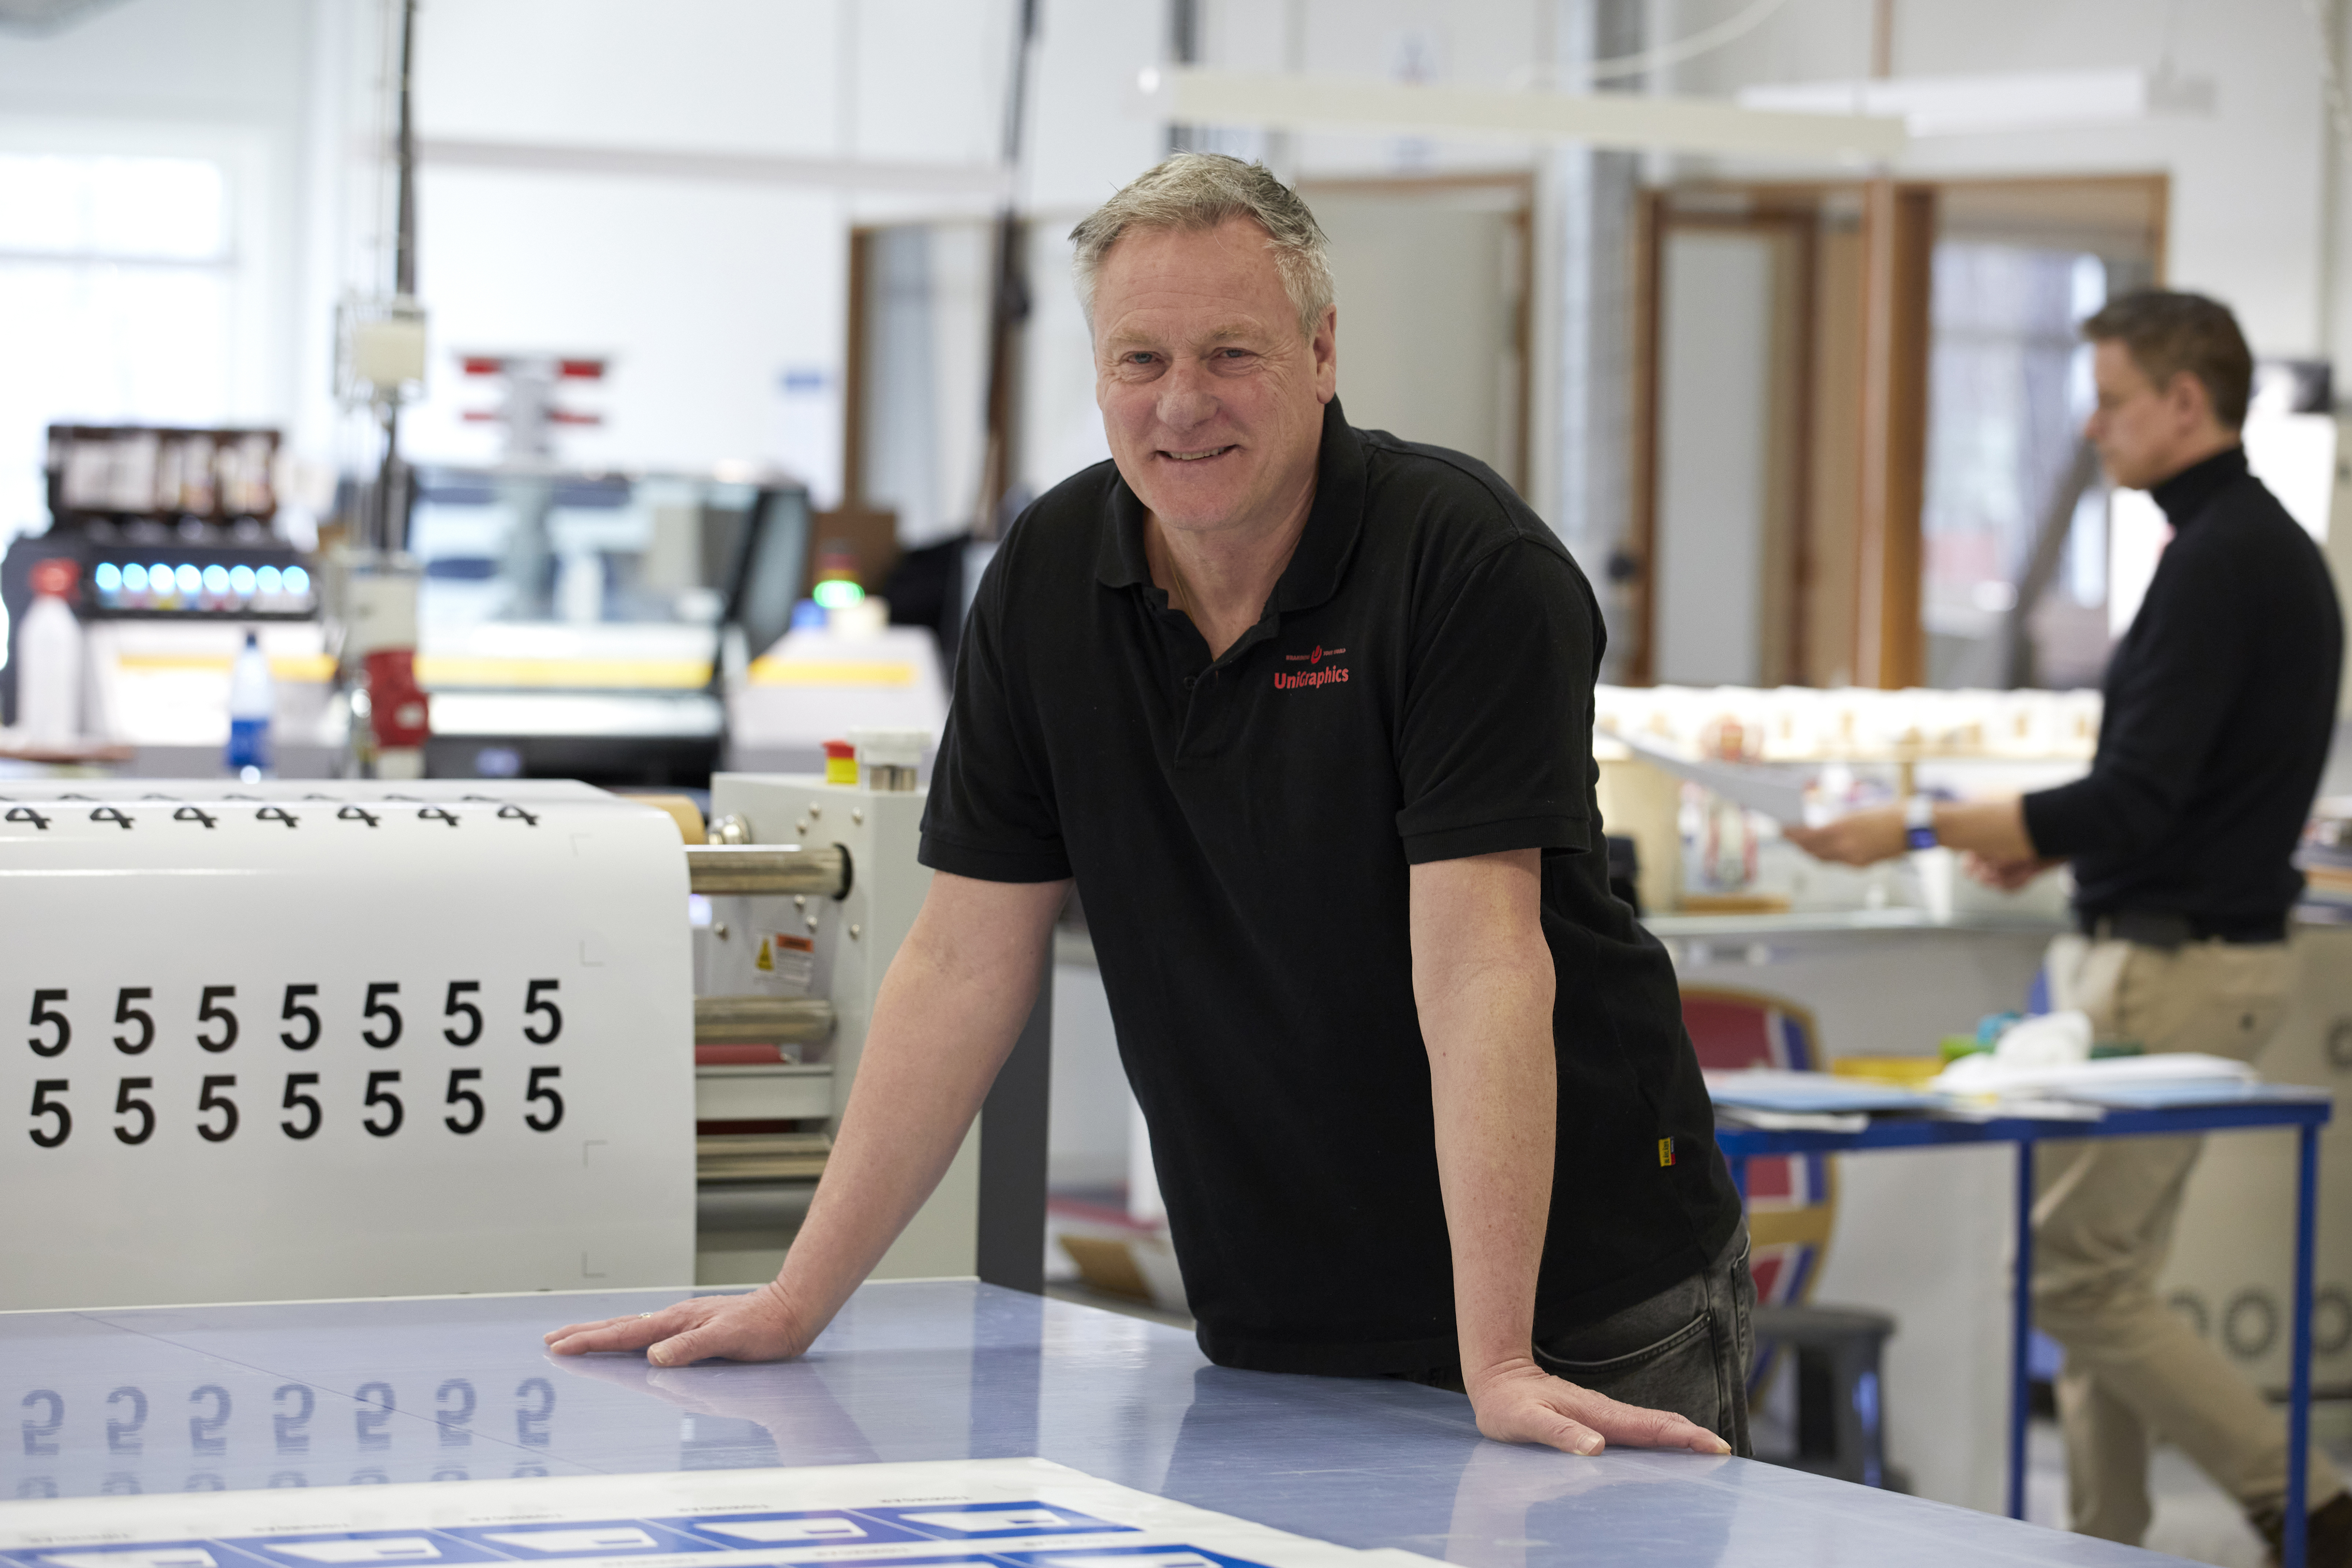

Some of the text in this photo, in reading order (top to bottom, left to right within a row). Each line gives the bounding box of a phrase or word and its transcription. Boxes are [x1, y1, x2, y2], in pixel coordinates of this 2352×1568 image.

[1274, 665, 1349, 689] UniGraphics
[5, 805, 539, 829] 4 4 4 4 4 4 4
[28, 979, 562, 1058] 5 5 5 5 5 5 5
[29, 1066, 564, 1149] 5 5 5 5 5 5 5
